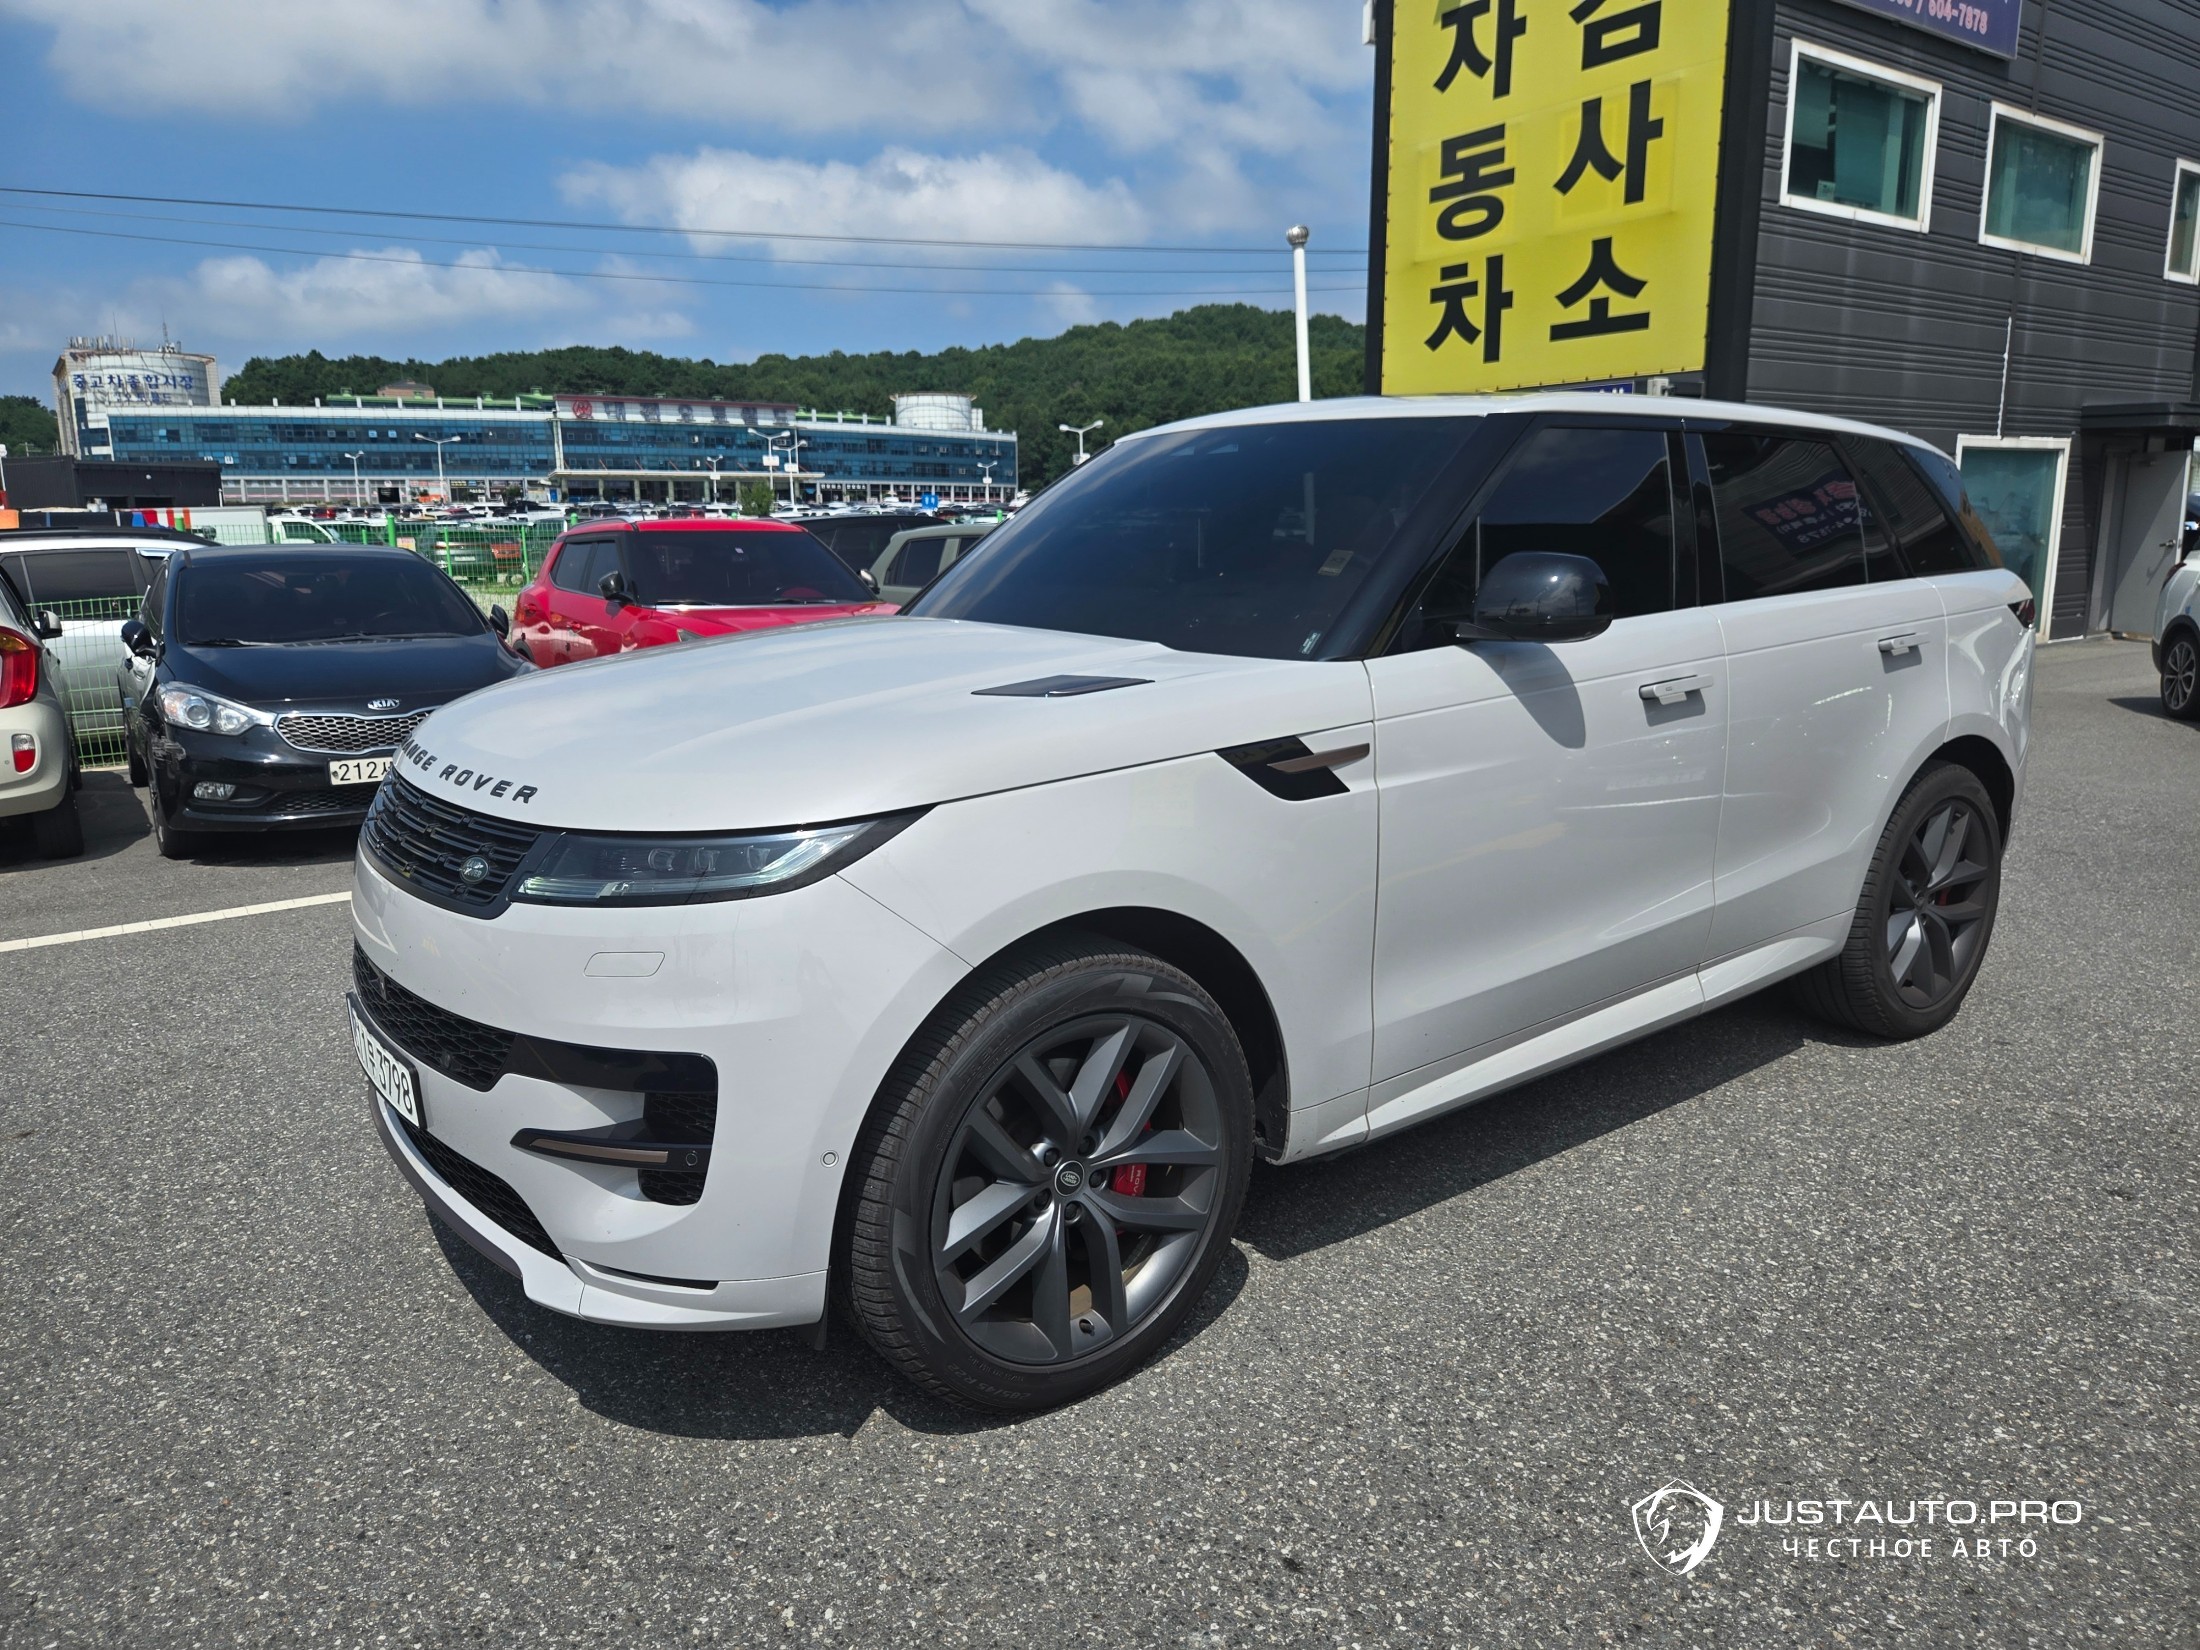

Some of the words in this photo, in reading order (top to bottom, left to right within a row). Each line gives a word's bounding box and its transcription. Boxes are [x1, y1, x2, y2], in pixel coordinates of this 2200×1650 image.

[372, 698, 397, 709] KIA
[401, 738, 438, 771] ANGE
[439, 763, 539, 804] ROVER
